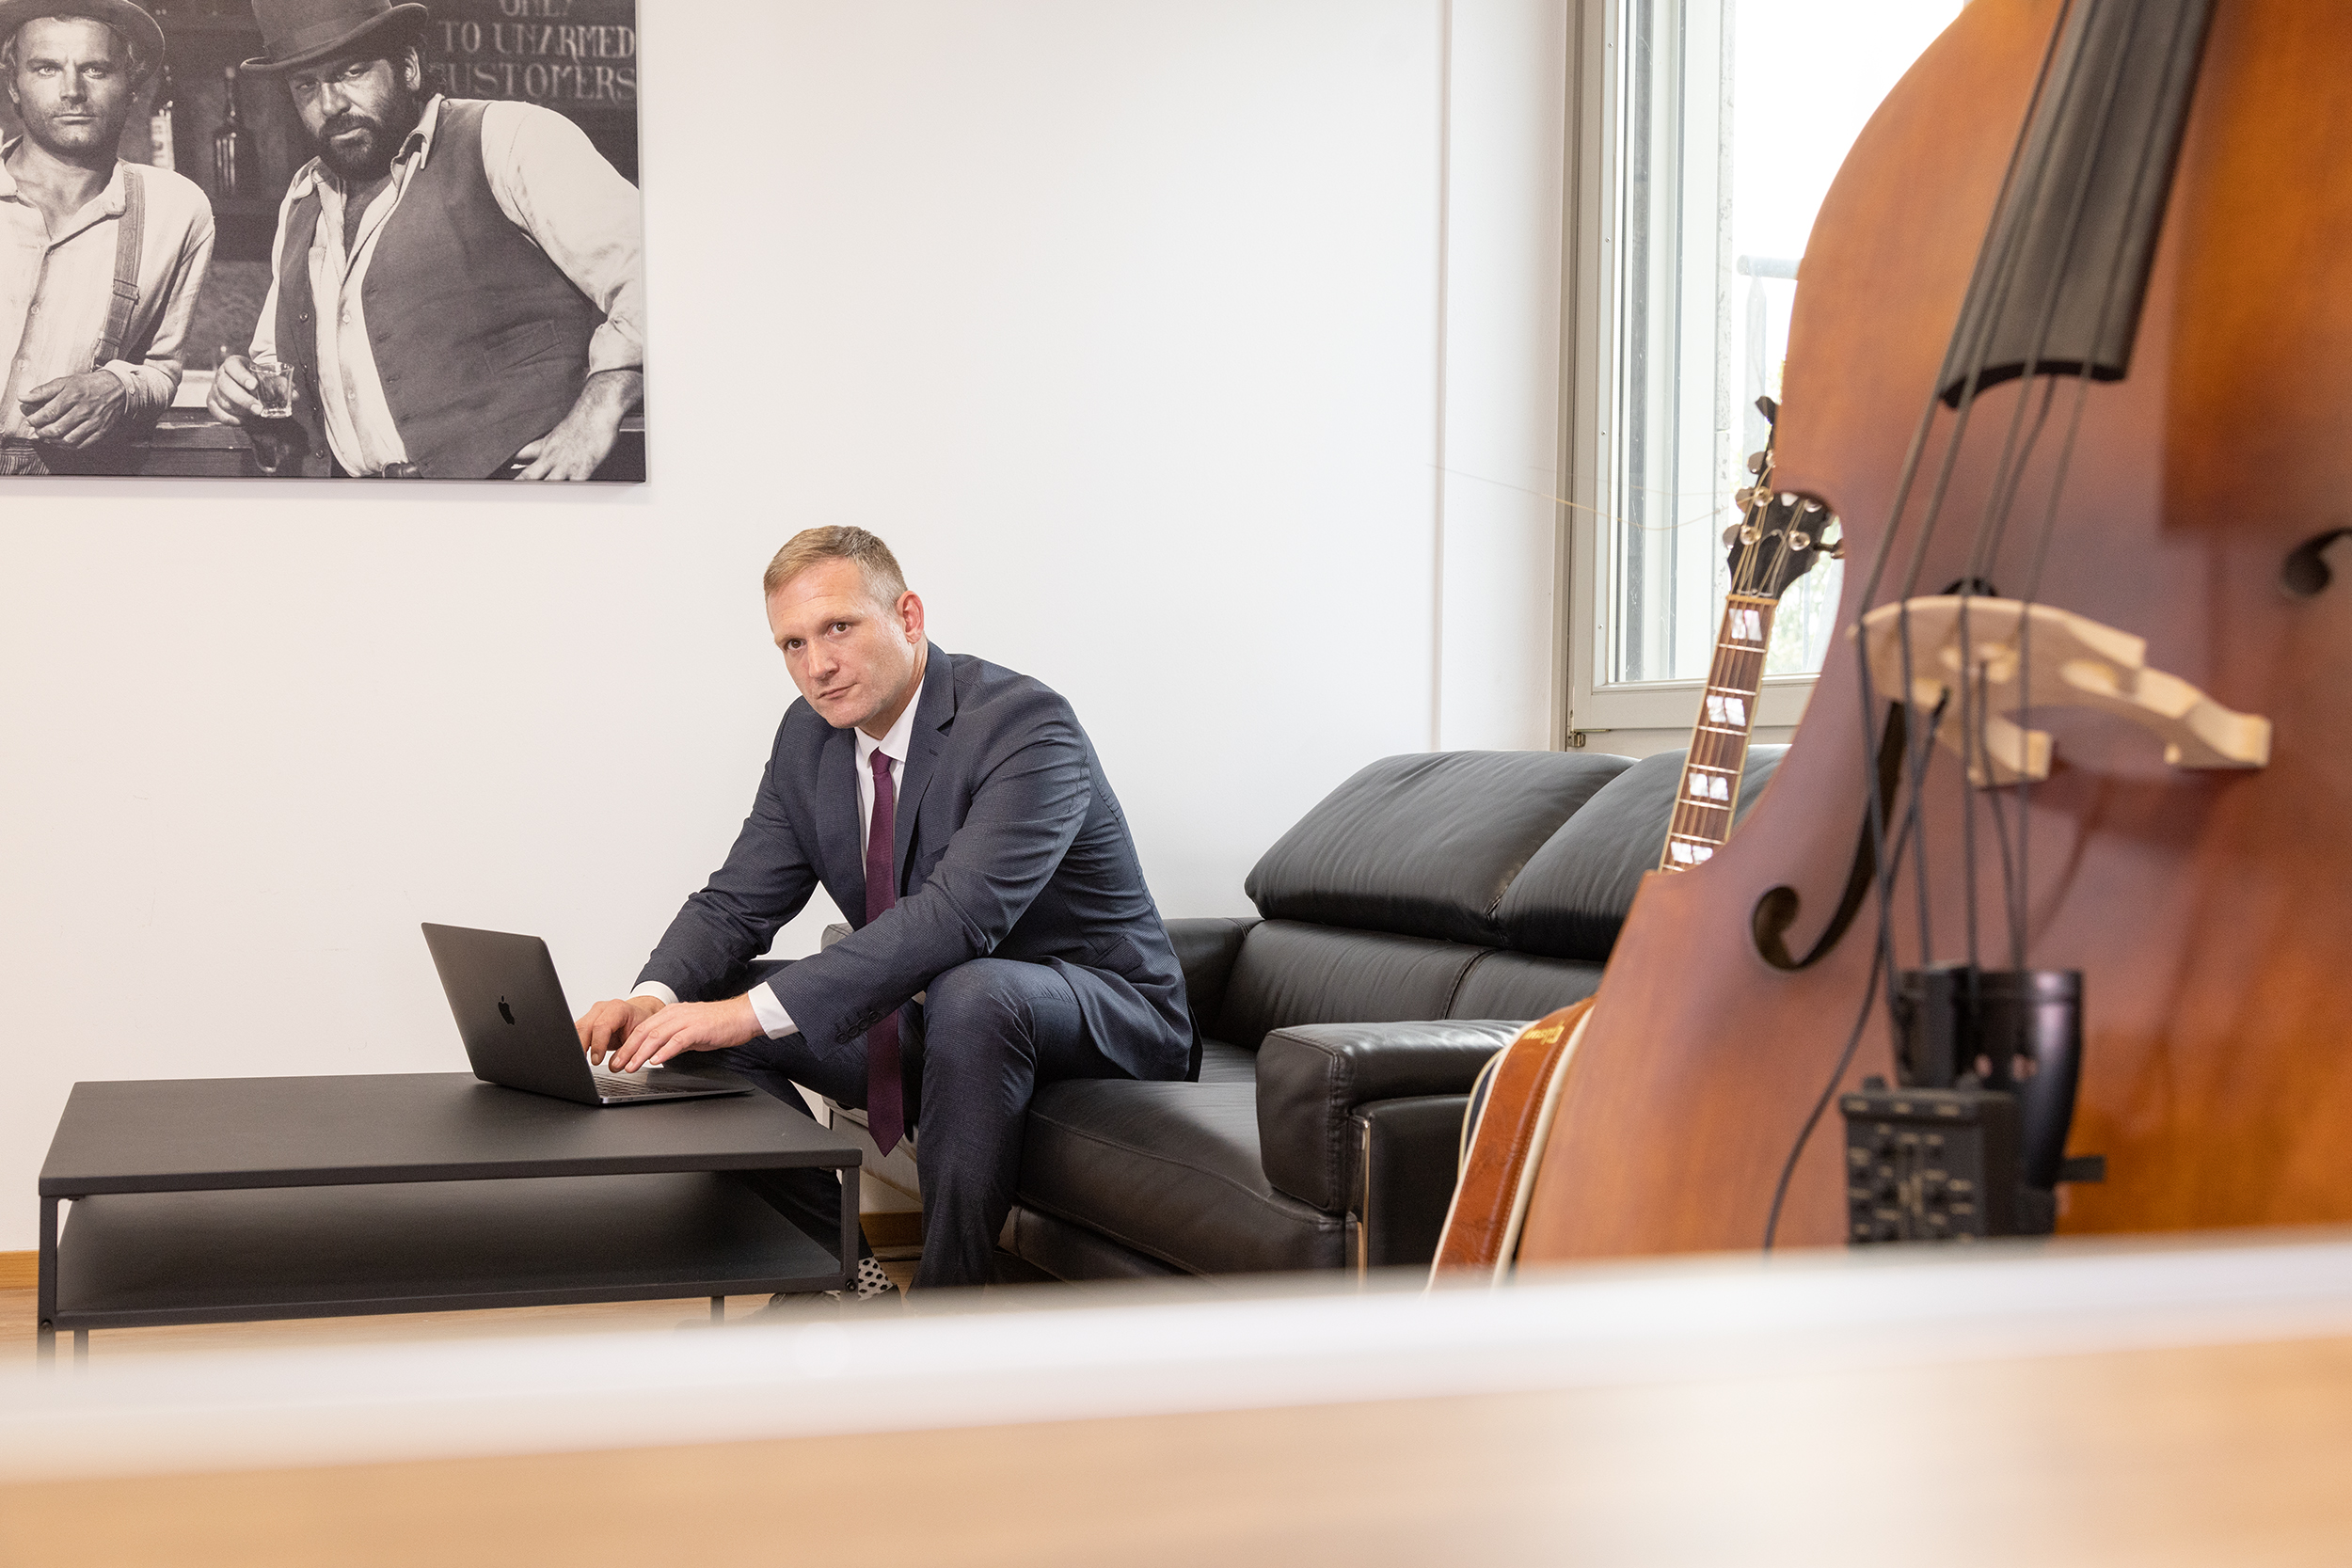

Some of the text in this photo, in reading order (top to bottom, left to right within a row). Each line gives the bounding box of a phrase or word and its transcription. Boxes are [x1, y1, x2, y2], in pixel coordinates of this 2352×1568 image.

[438, 21, 635, 64] TO UNARMED
[431, 62, 636, 103] USTOMERS
